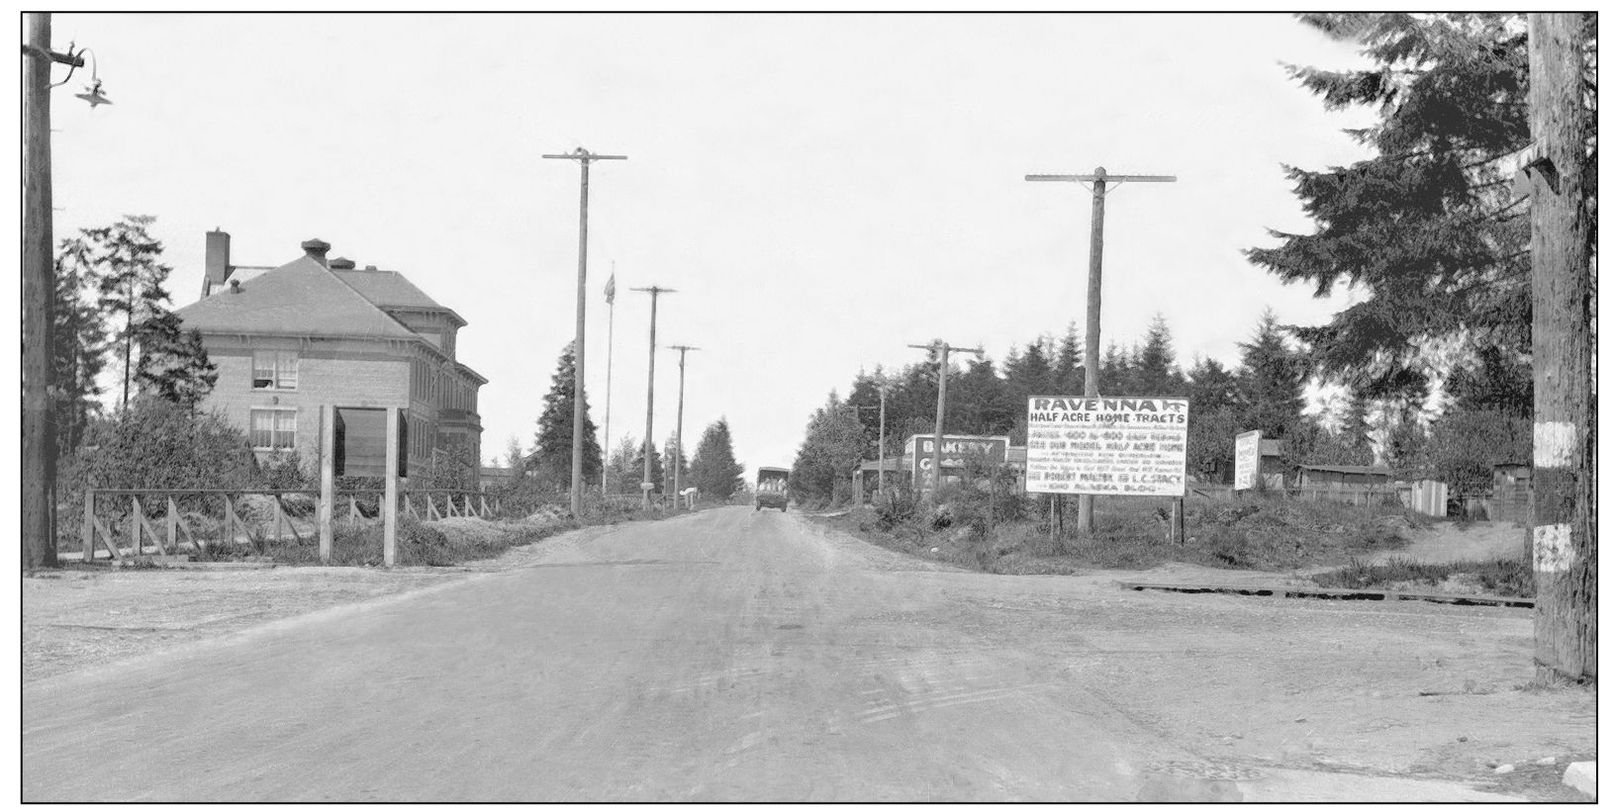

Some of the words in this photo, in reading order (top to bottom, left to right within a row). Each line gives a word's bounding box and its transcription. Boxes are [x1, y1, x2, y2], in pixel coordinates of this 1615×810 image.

[1035, 399, 1157, 412] RAVENNA
[1031, 412, 1059, 422] HALF
[1061, 412, 1091, 422] ACRE
[1096, 413, 1130, 423] HOME
[1135, 413, 1185, 423] TRACTS
